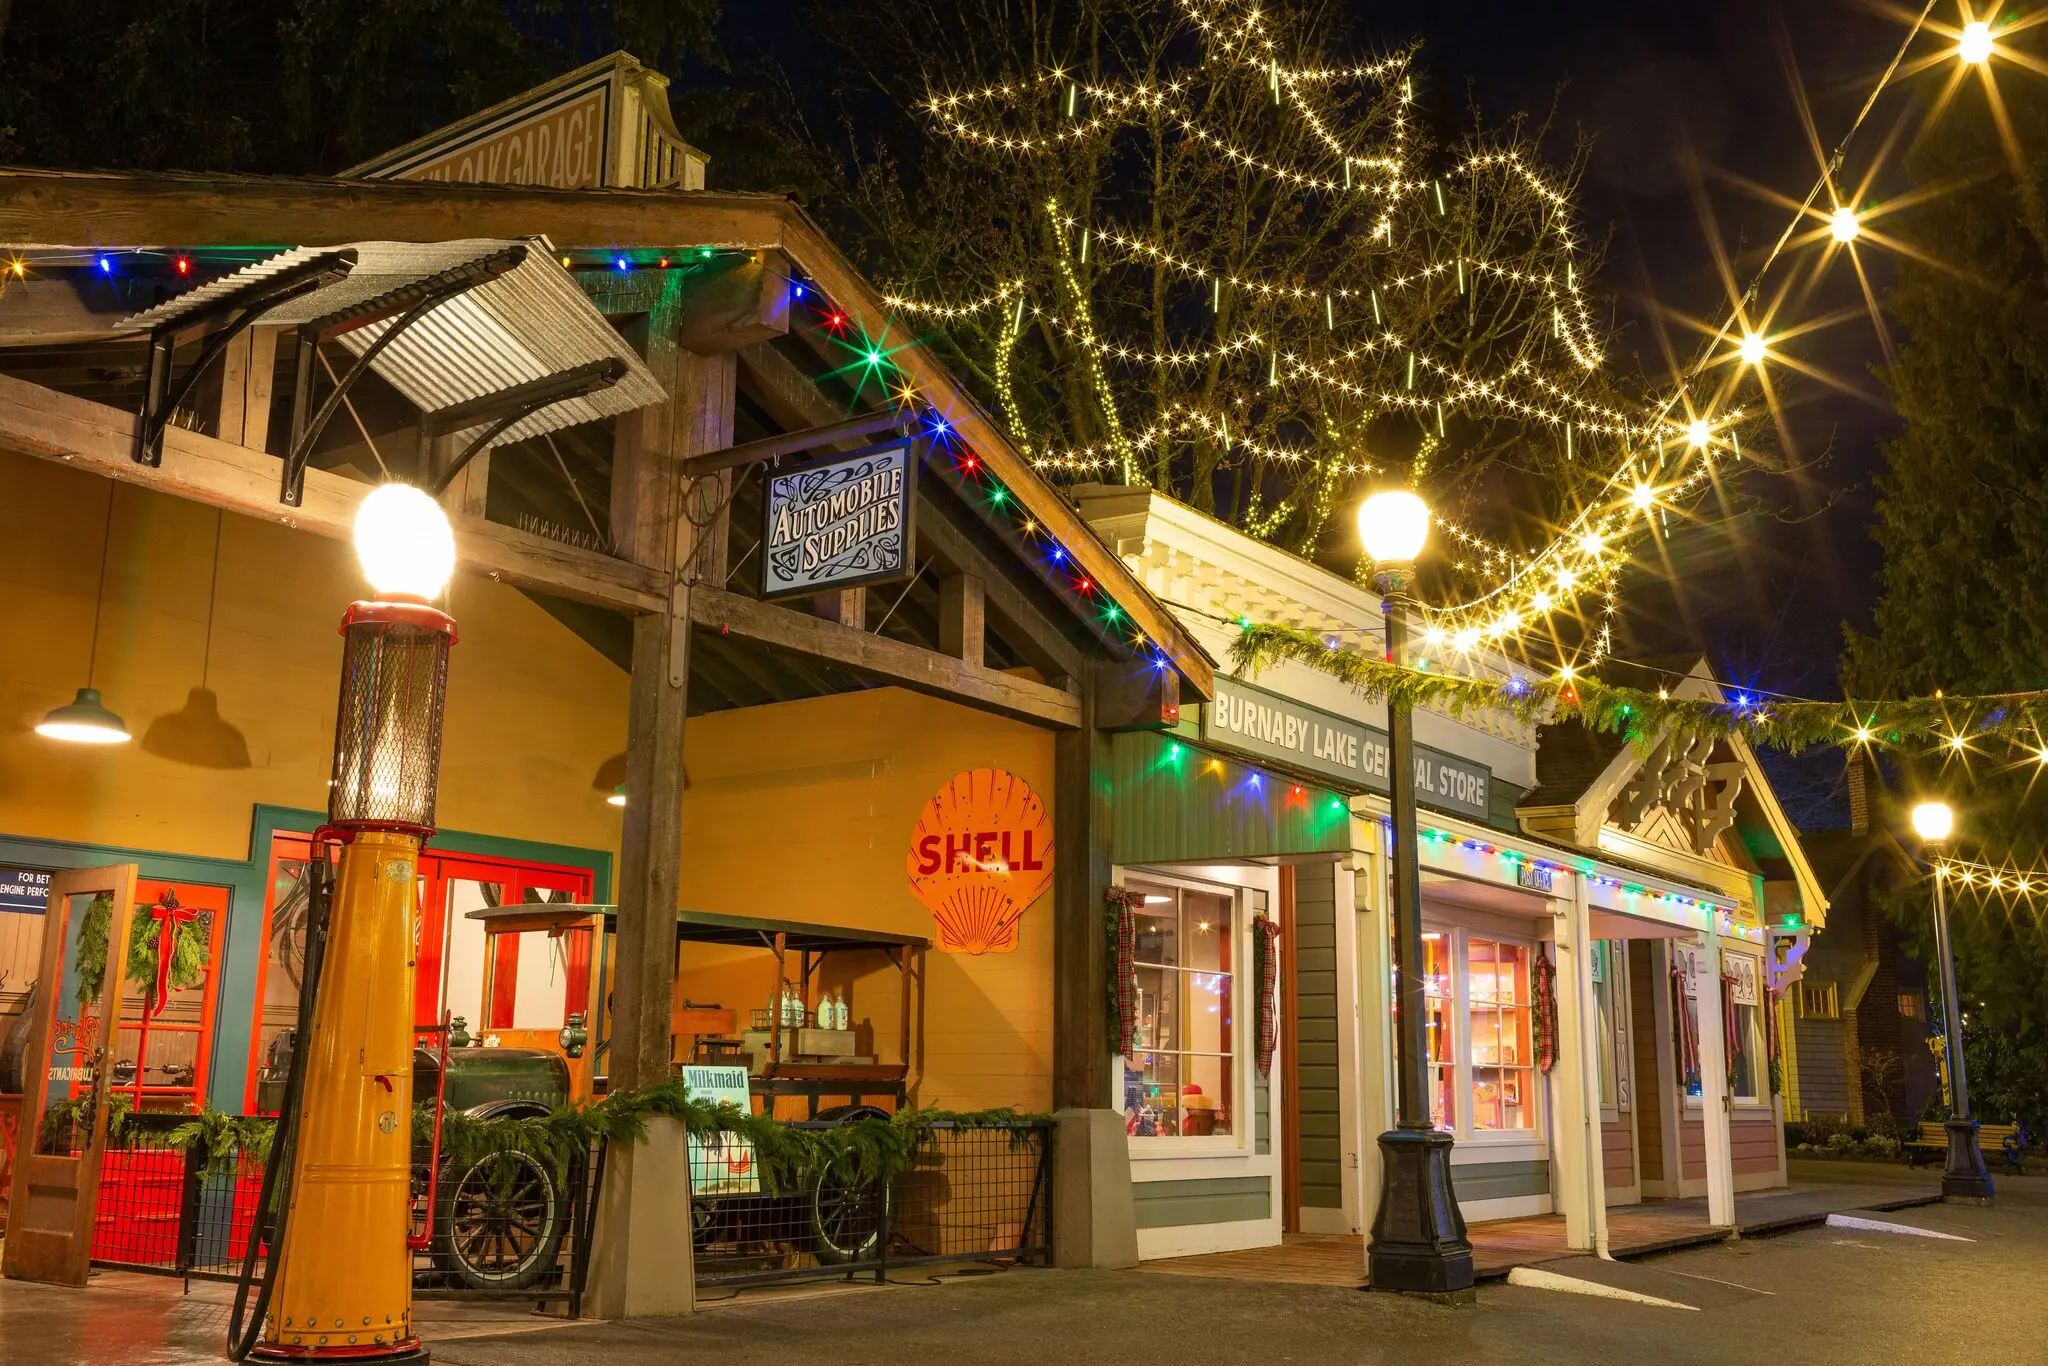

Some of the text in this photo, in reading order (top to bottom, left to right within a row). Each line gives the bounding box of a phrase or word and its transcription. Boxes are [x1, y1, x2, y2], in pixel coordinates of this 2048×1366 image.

[504, 104, 596, 187] GARAGE
[770, 467, 902, 548] AUTOMOBILE
[802, 497, 899, 573] SUPPLIES
[1214, 691, 1308, 753] BURNABY
[1313, 724, 1357, 769] LAKE
[1439, 765, 1484, 807] STORE
[18, 872, 34, 883] FOR
[917, 830, 1043, 876] SHELL
[0, 884, 25, 895] ENGINE
[688, 1070, 744, 1088] Milkmaid
